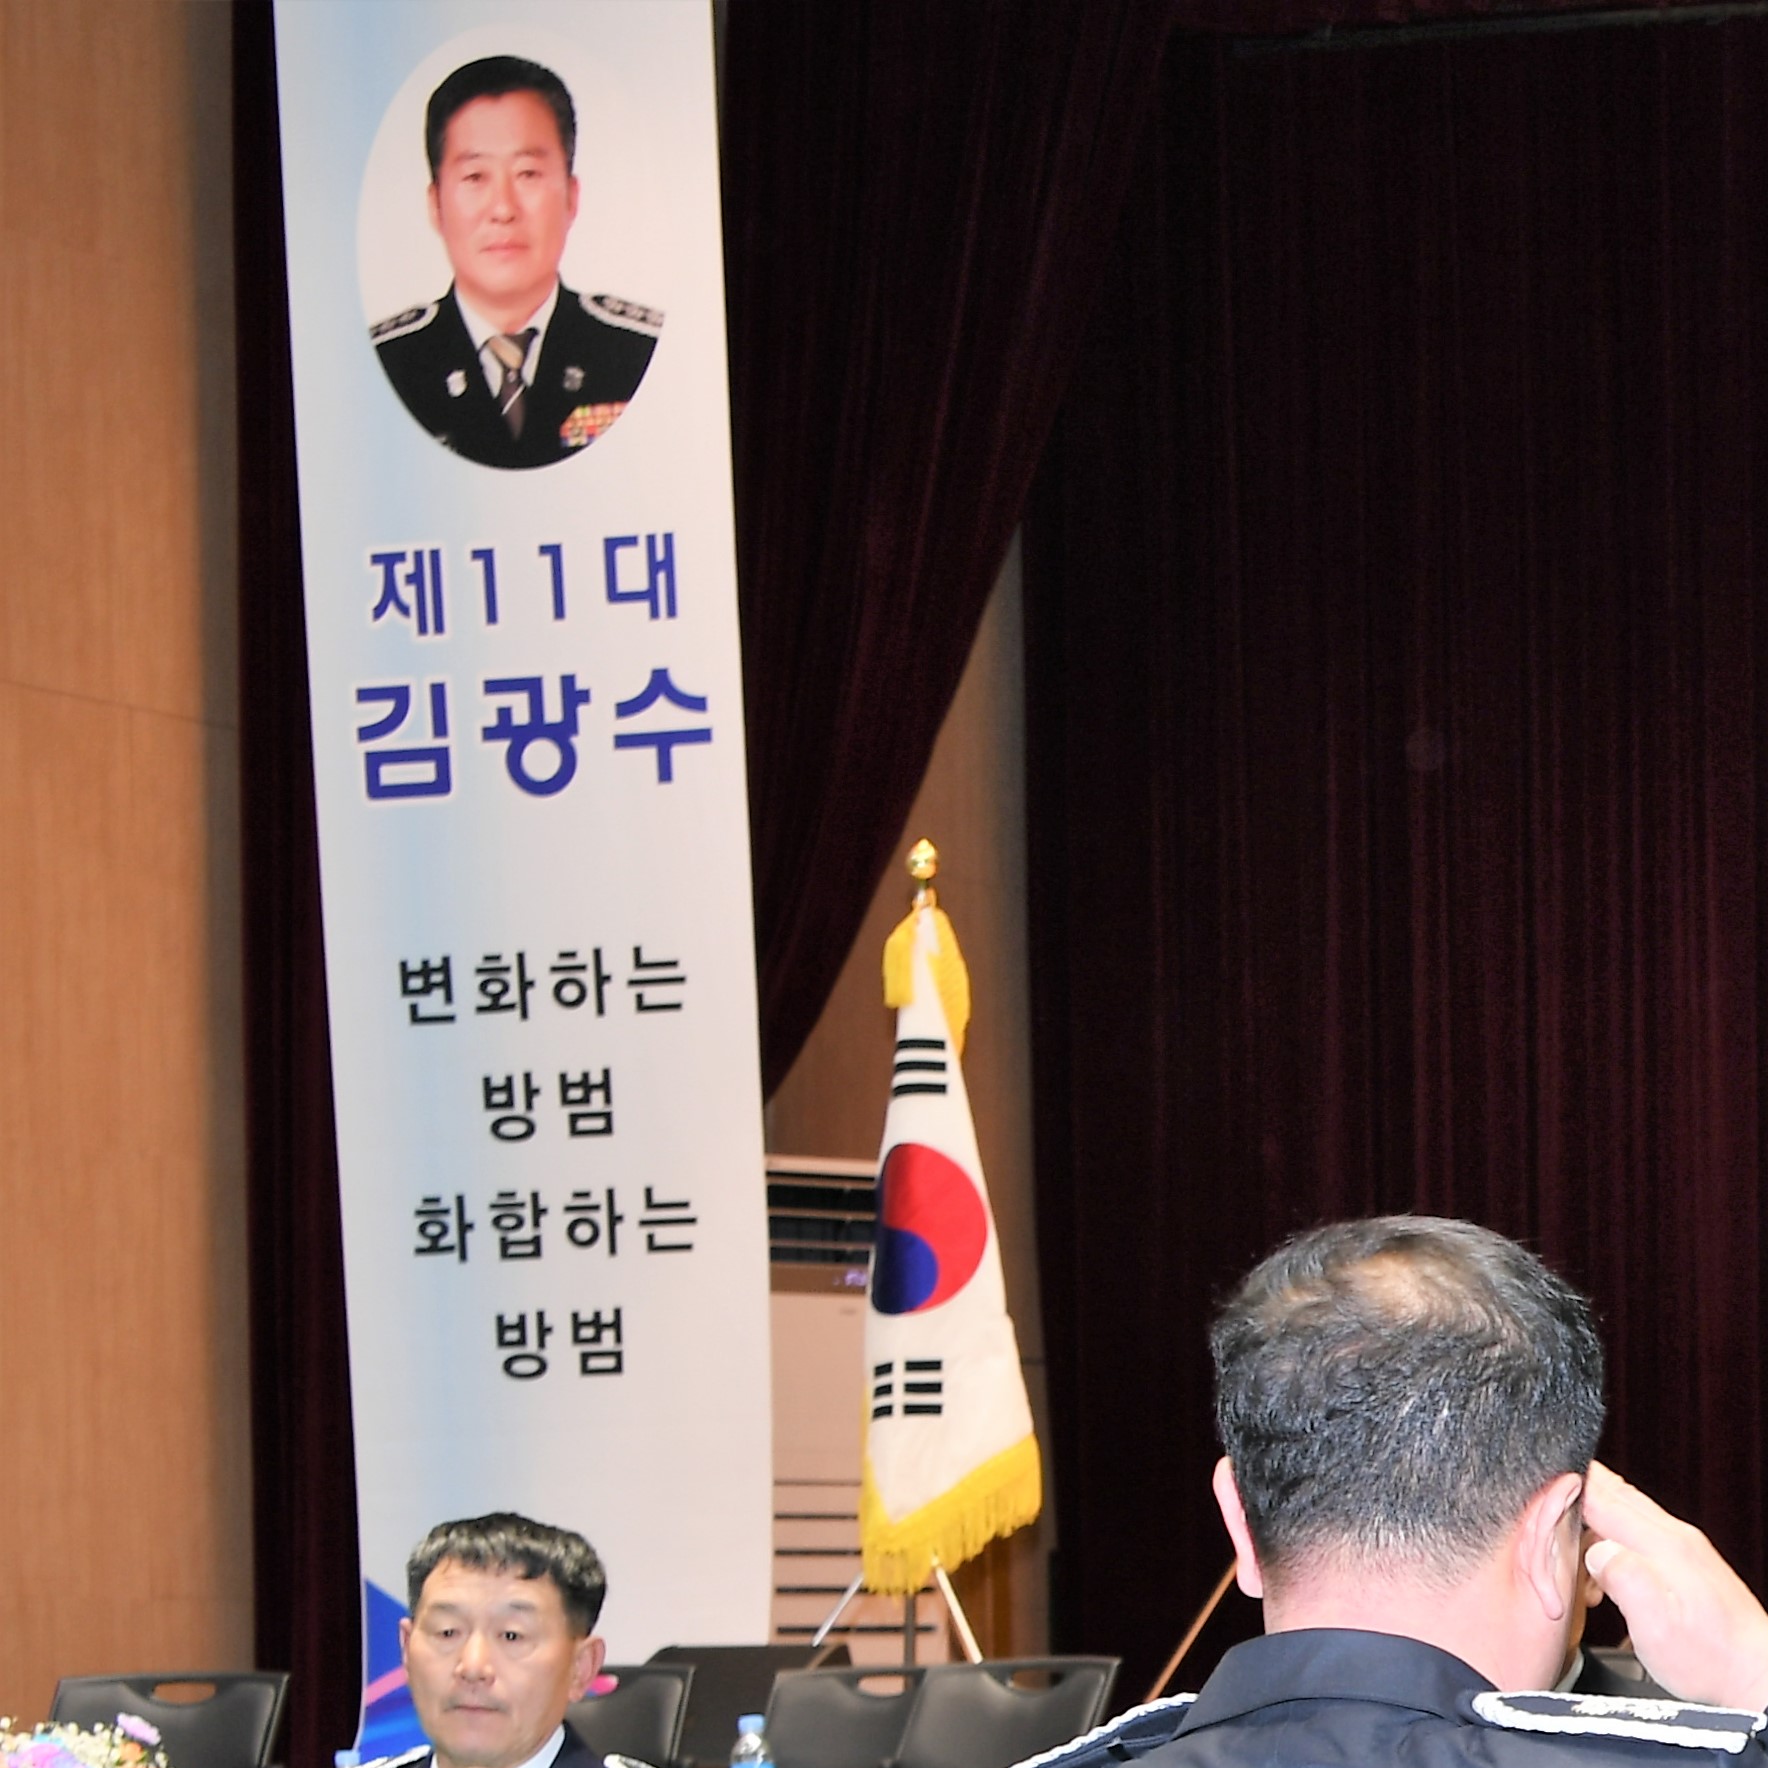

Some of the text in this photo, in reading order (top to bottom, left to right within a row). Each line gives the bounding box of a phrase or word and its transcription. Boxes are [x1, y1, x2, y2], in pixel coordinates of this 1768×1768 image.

[368, 532, 678, 637] 제11대
[355, 667, 714, 800] 김광수
[400, 946, 687, 1026] 변화하는
[482, 1068, 614, 1143] 방범
[414, 1186, 698, 1263] 화합하는
[495, 1307, 624, 1380] 방범
